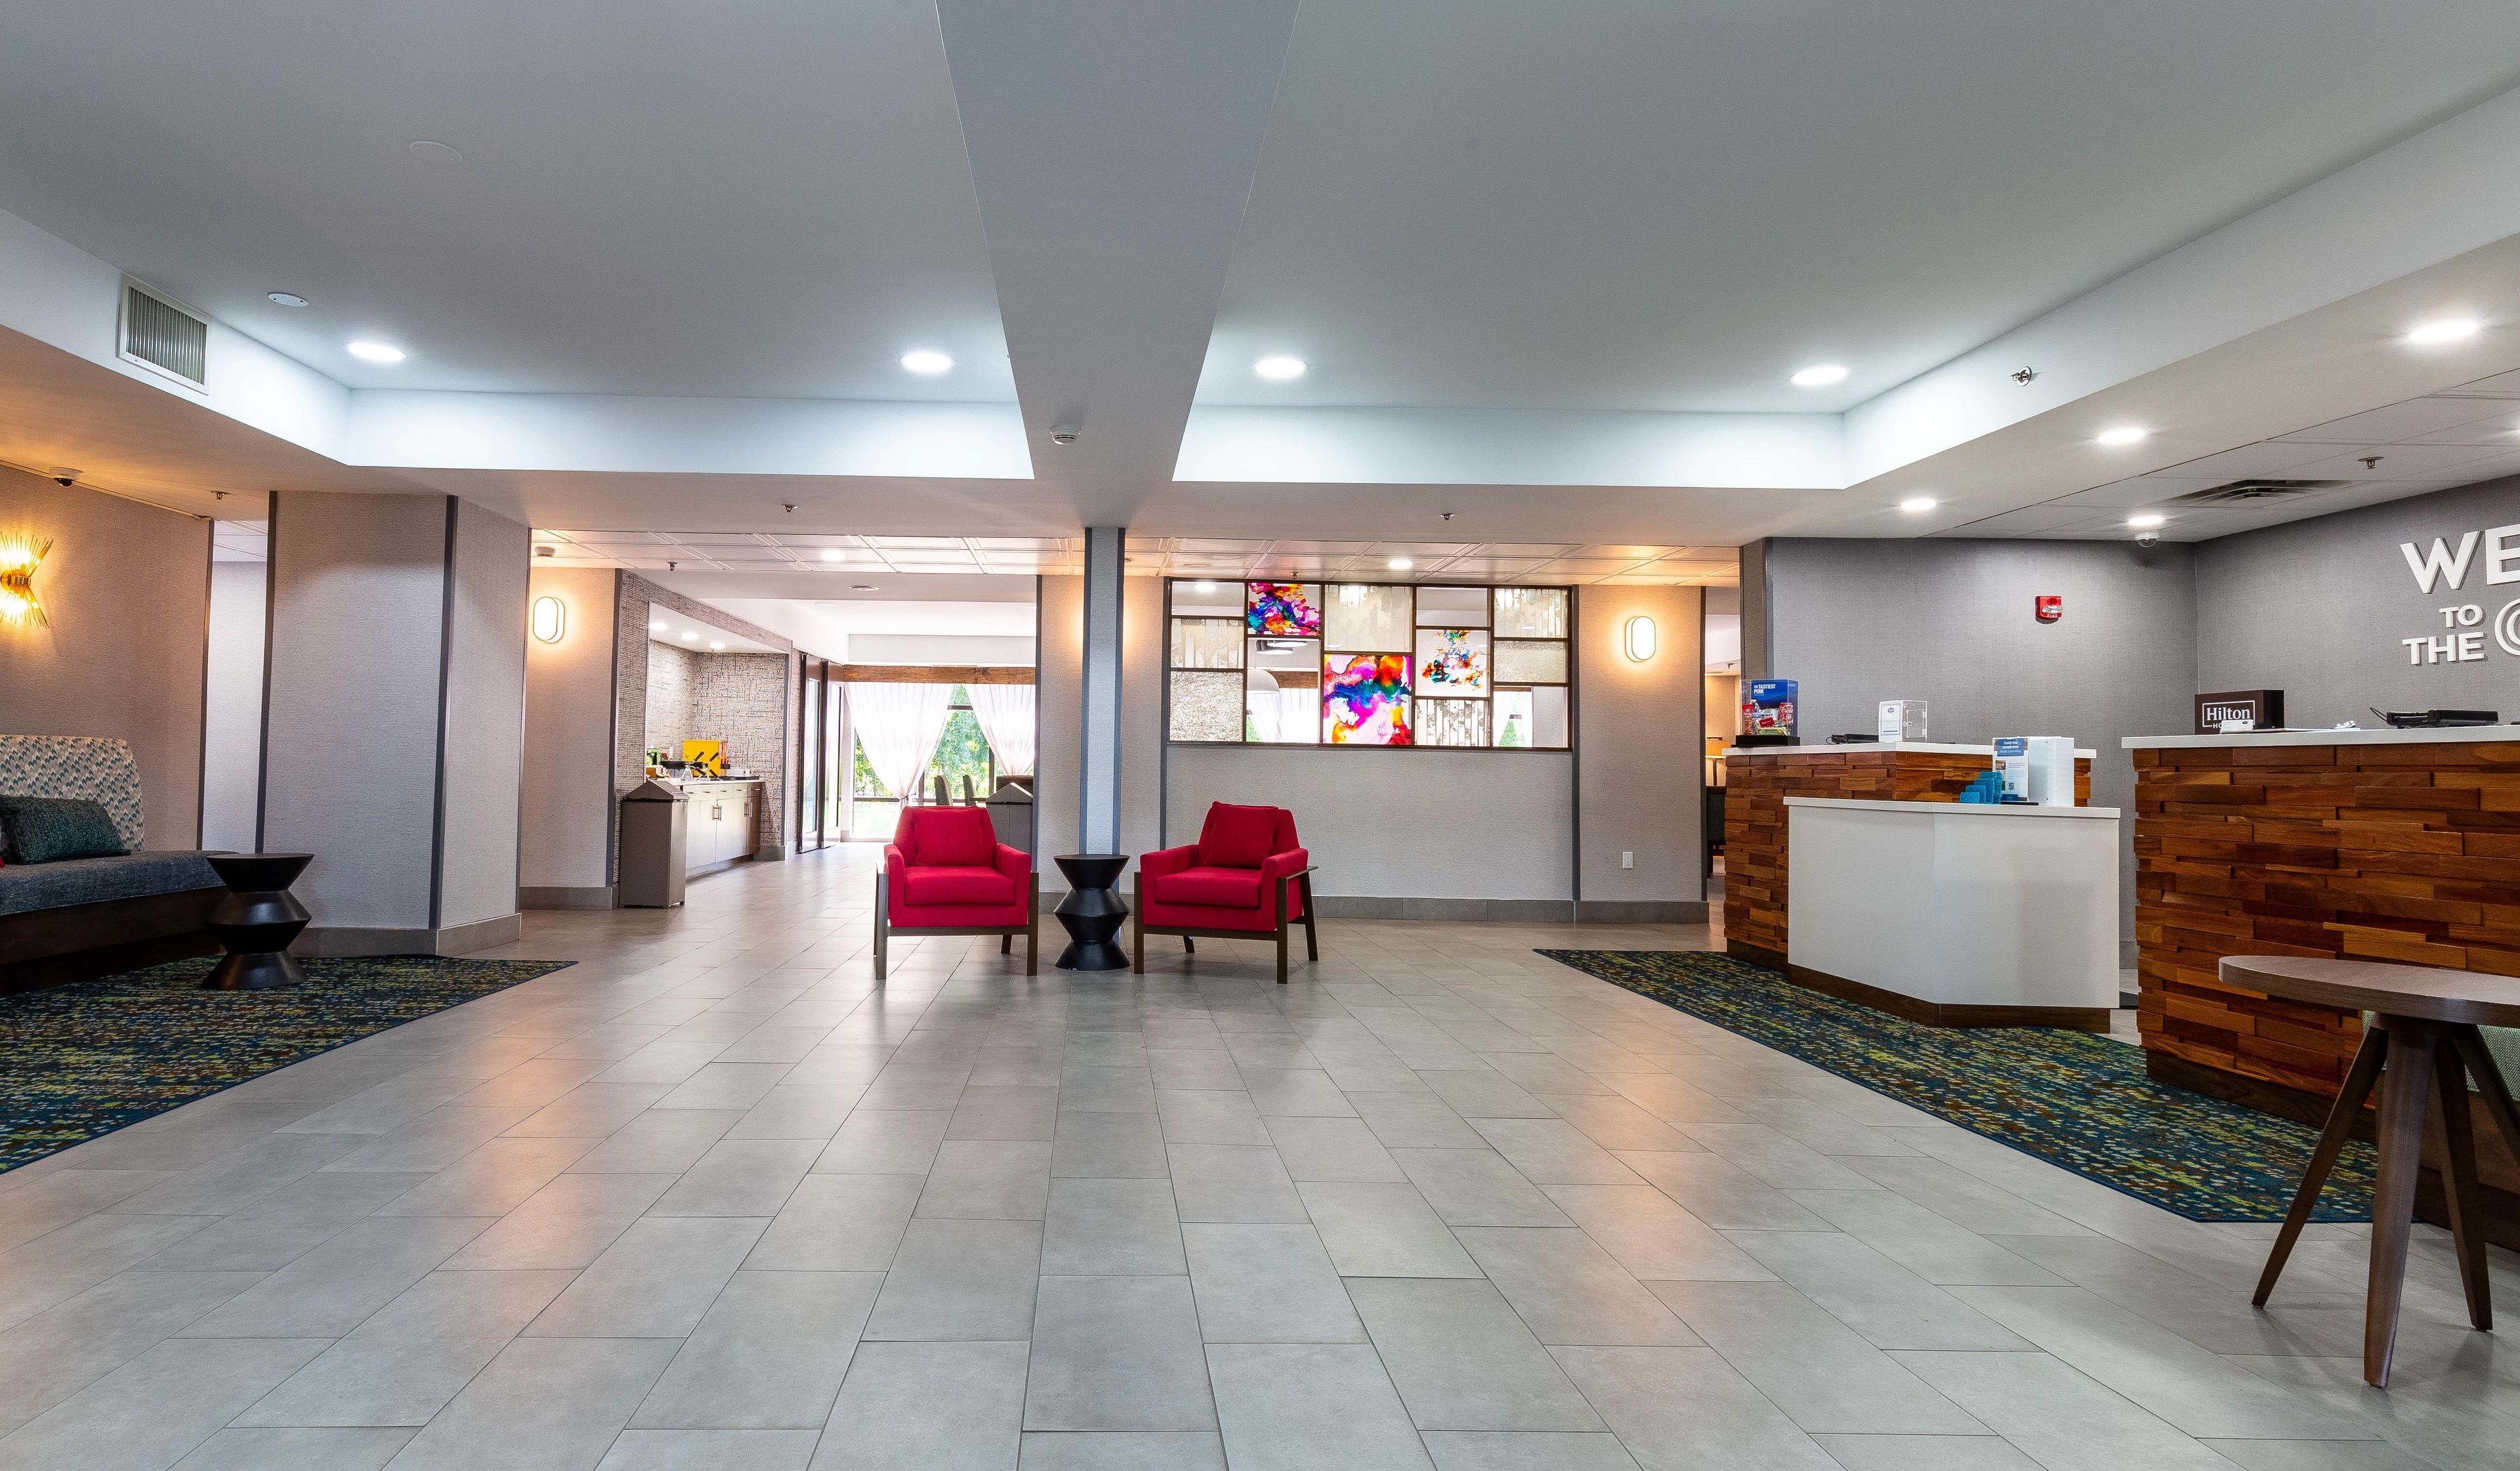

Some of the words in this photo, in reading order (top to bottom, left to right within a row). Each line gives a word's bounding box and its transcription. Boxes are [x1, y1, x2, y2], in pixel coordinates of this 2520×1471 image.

[2439, 604, 2484, 628] TO
[2402, 631, 2485, 665] THE
[2206, 707, 2250, 721] Hilton
